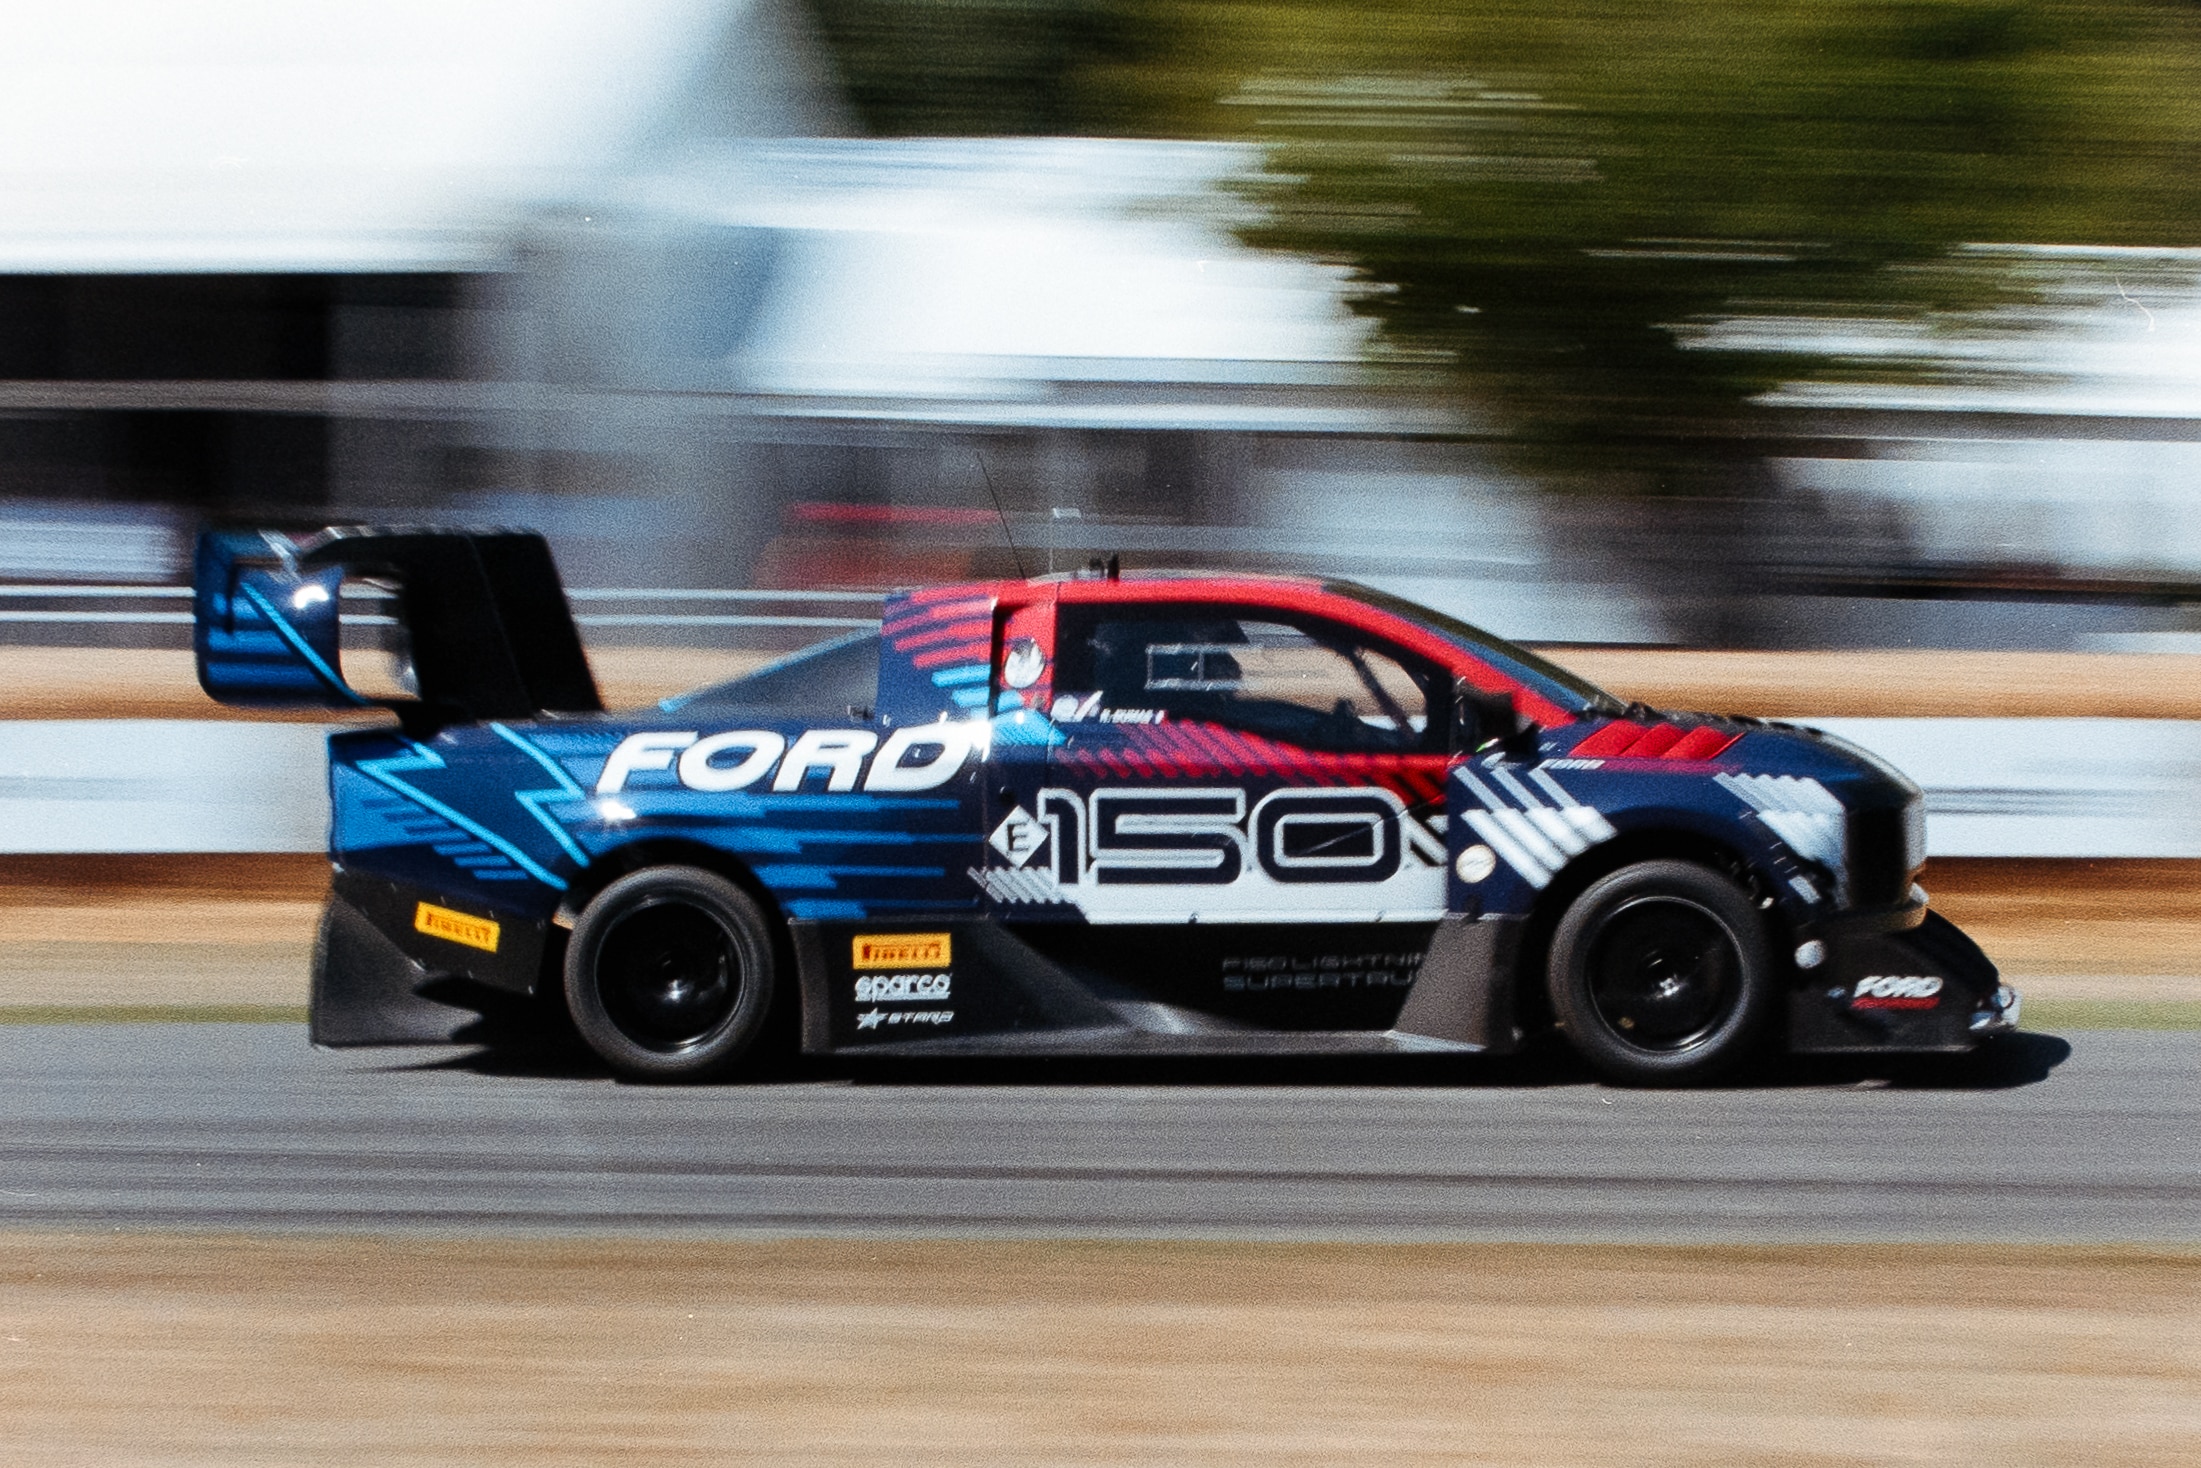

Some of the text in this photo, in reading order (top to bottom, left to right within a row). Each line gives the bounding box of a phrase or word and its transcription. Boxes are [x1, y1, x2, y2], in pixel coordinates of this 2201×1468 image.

[597, 724, 972, 793] FORD
[1038, 787, 1409, 885] 150
[422, 910, 491, 943] PIRELLI
[860, 940, 940, 961] PIRELLI
[854, 973, 952, 1003] sparco
[1853, 975, 1943, 998] FORD
